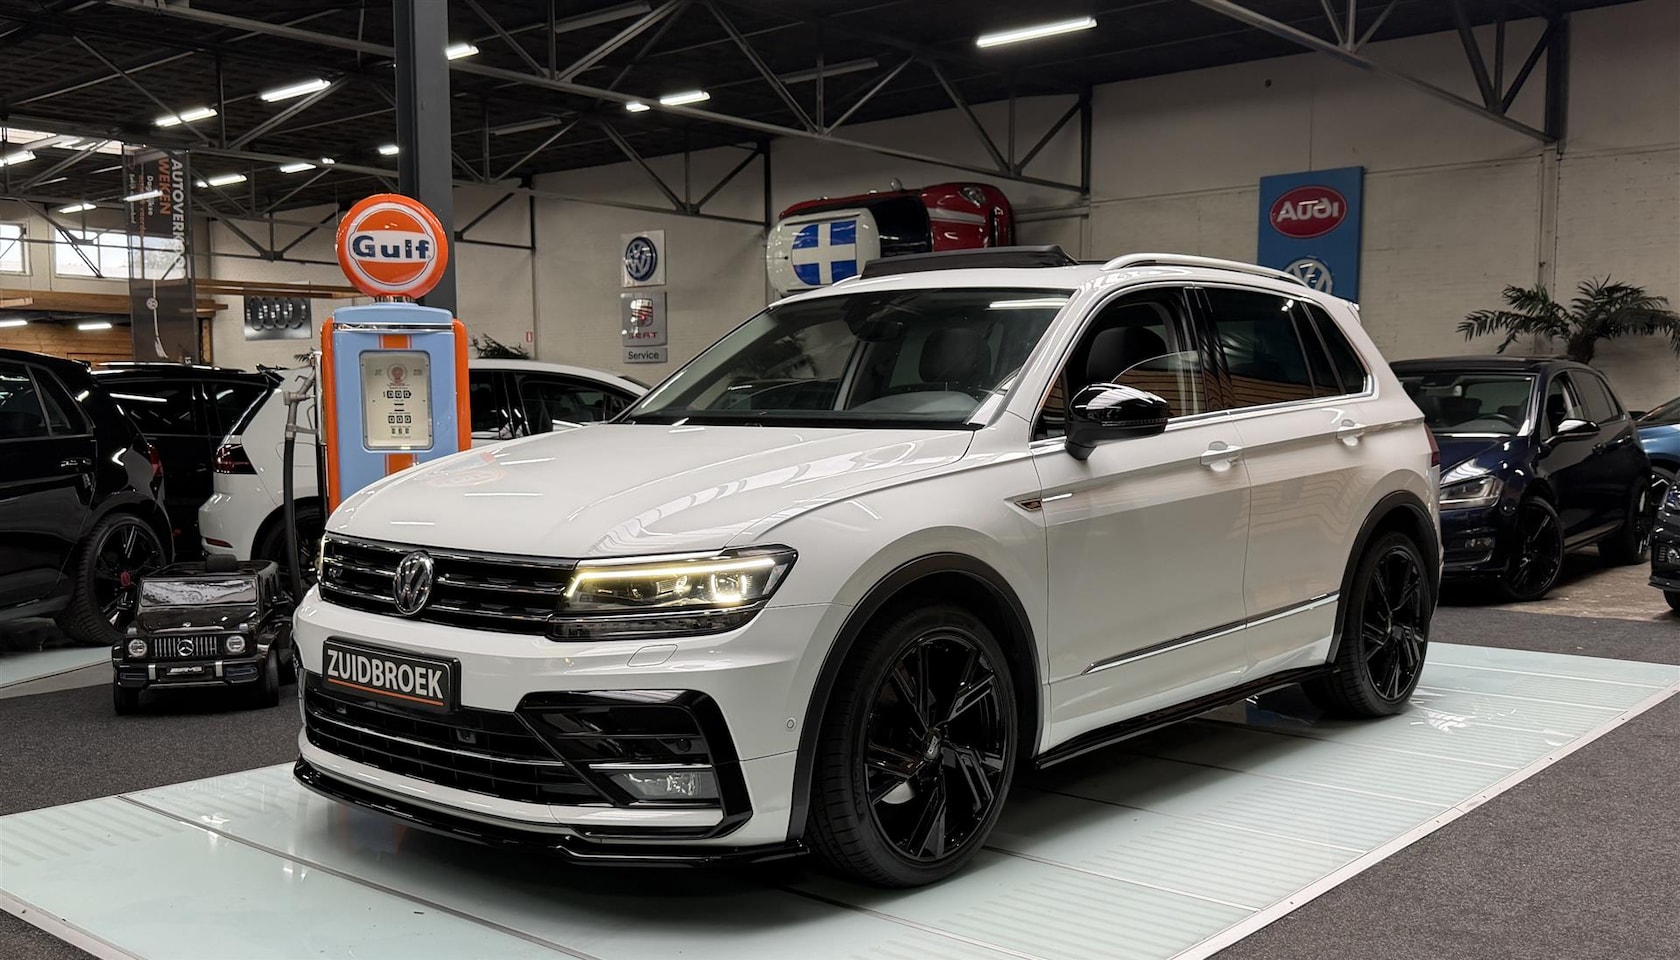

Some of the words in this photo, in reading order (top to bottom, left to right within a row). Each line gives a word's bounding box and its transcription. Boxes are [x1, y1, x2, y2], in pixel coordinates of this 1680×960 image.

[158, 158, 171, 215] WEKEN
[352, 235, 430, 259] Gulf
[628, 350, 659, 360] Service
[327, 649, 443, 699] ZUIDBROEK
